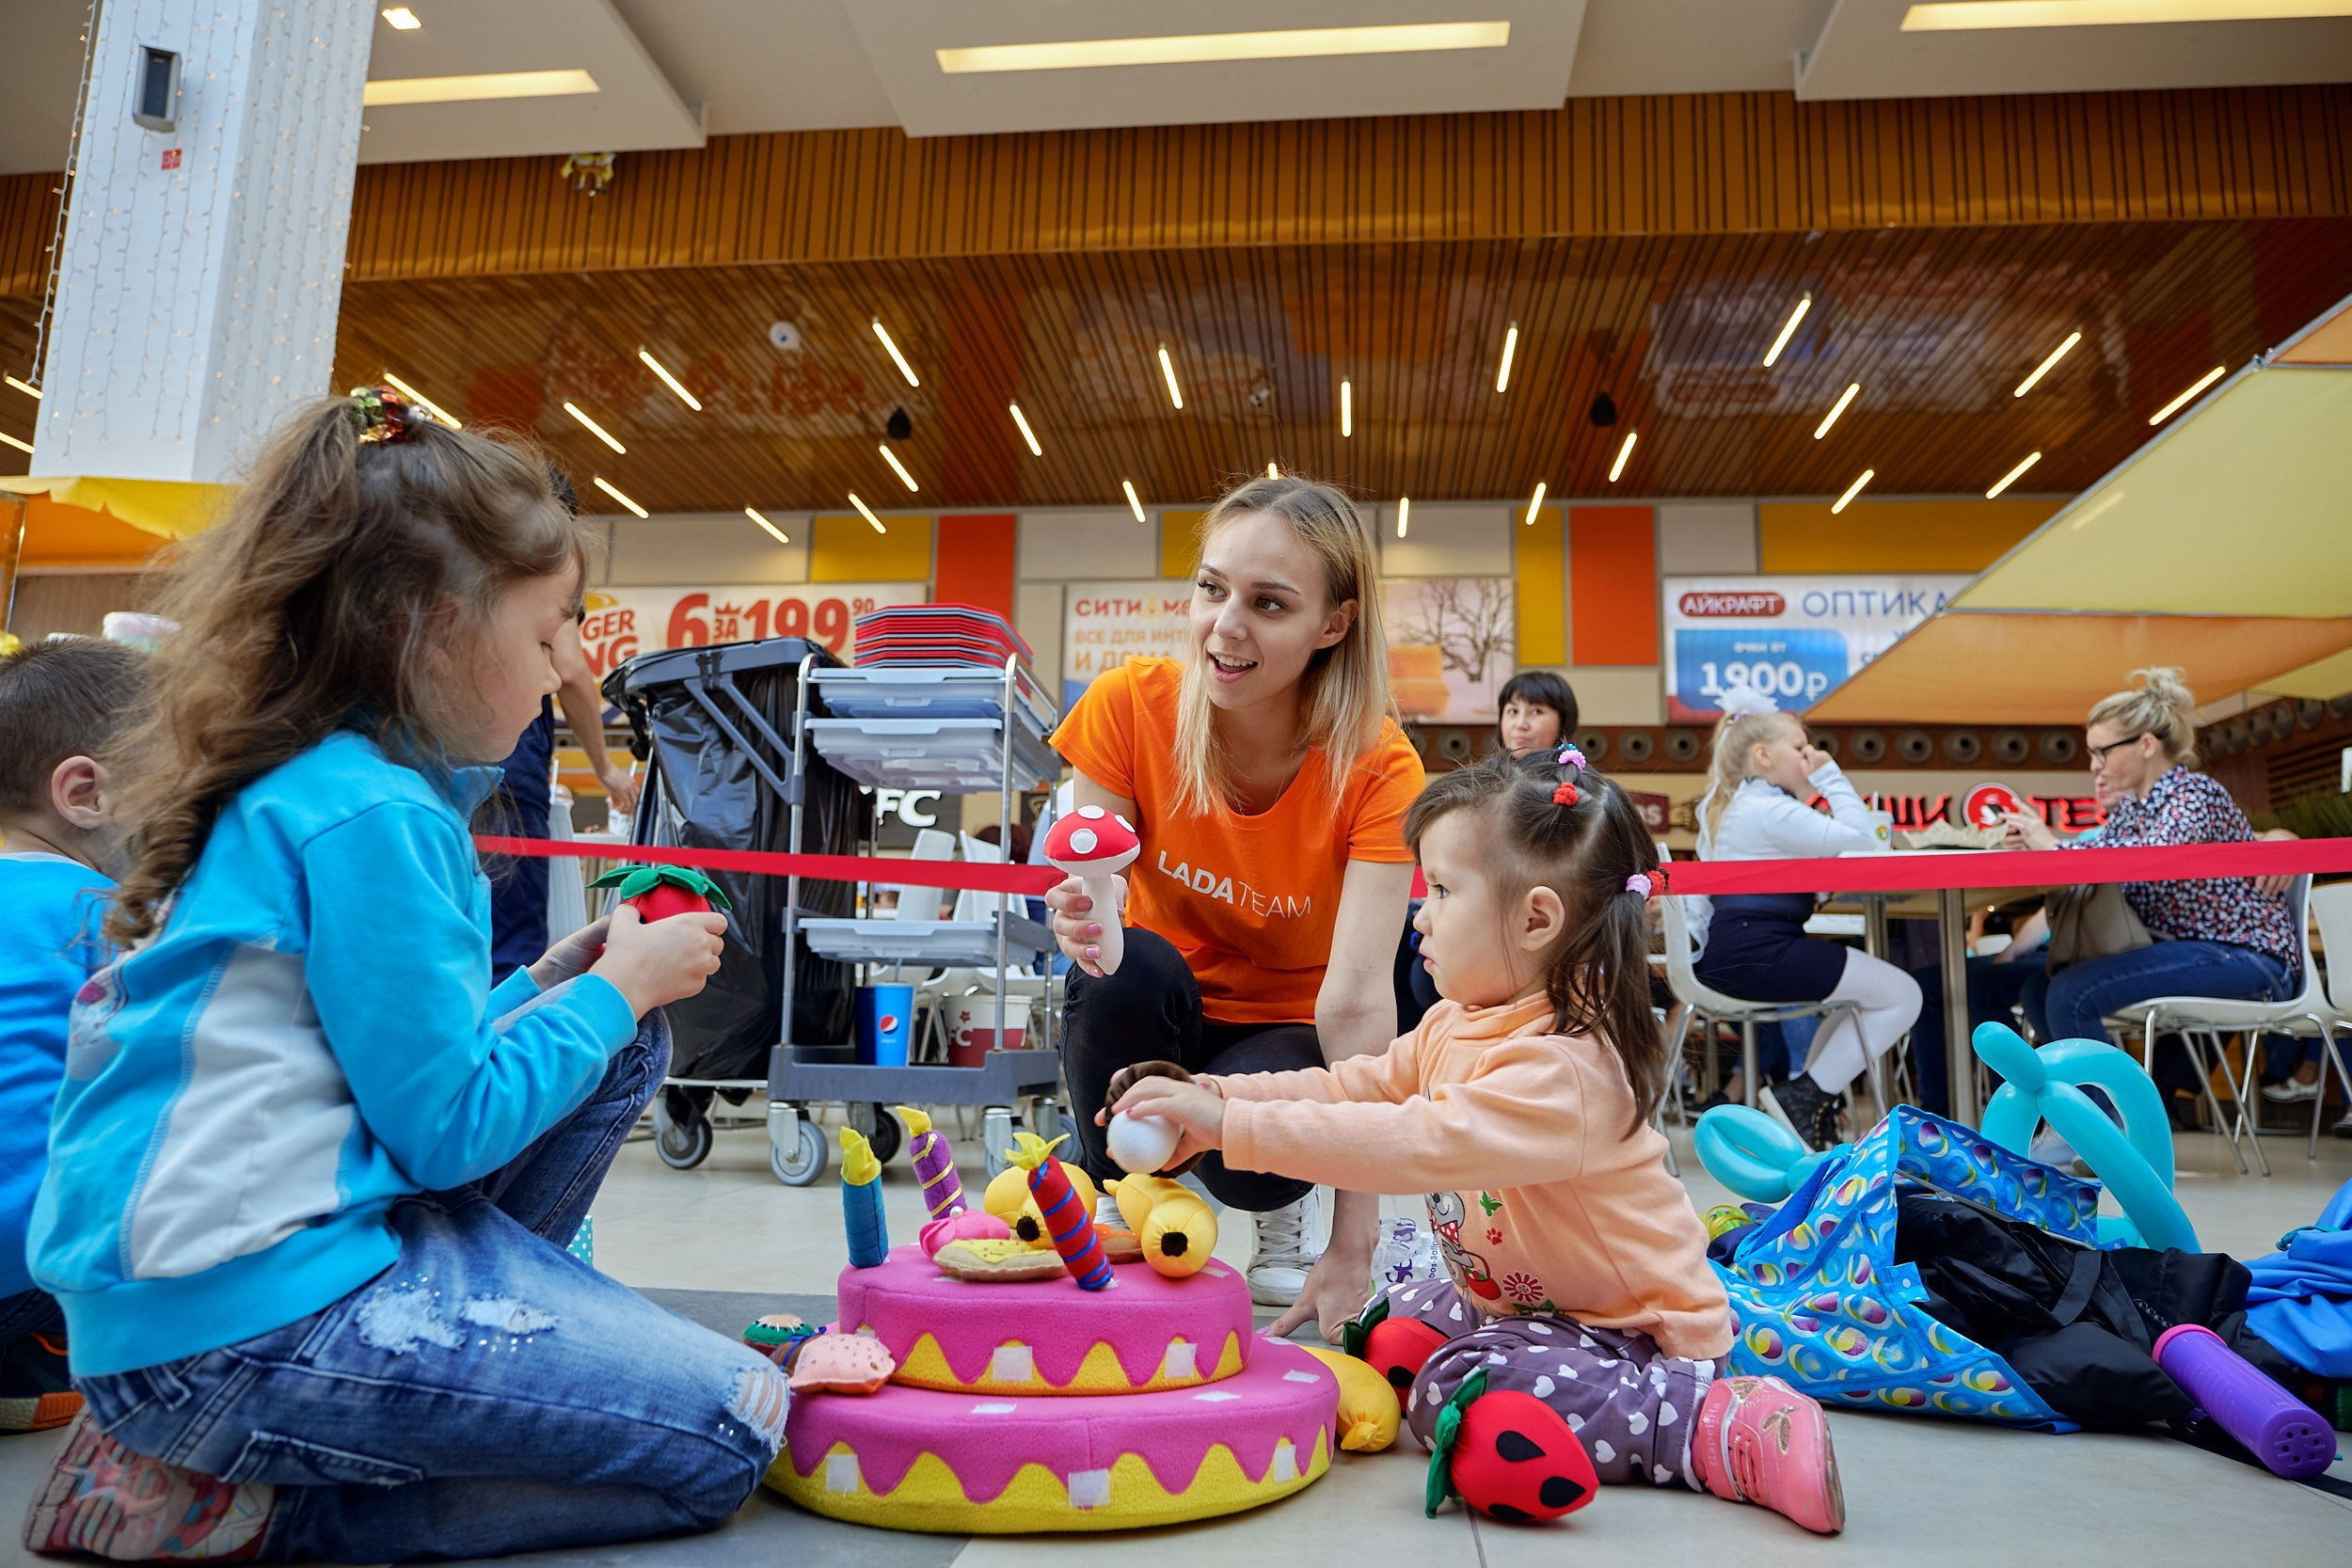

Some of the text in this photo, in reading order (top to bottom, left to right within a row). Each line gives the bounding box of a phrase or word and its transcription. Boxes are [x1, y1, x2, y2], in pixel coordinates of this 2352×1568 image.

[1075, 598, 1142, 617] СИТИ
[1683, 594, 1779, 615] АЙКРАФТ
[582, 610, 636, 641] GER
[666, 593, 711, 649] 6
[743, 598, 848, 657] 199
[1074, 629, 1190, 644] ВСЕ ДЛЯ ИНТ
[581, 636, 638, 677] NG
[1074, 652, 1091, 672] И
[858, 785, 942, 827] FC
